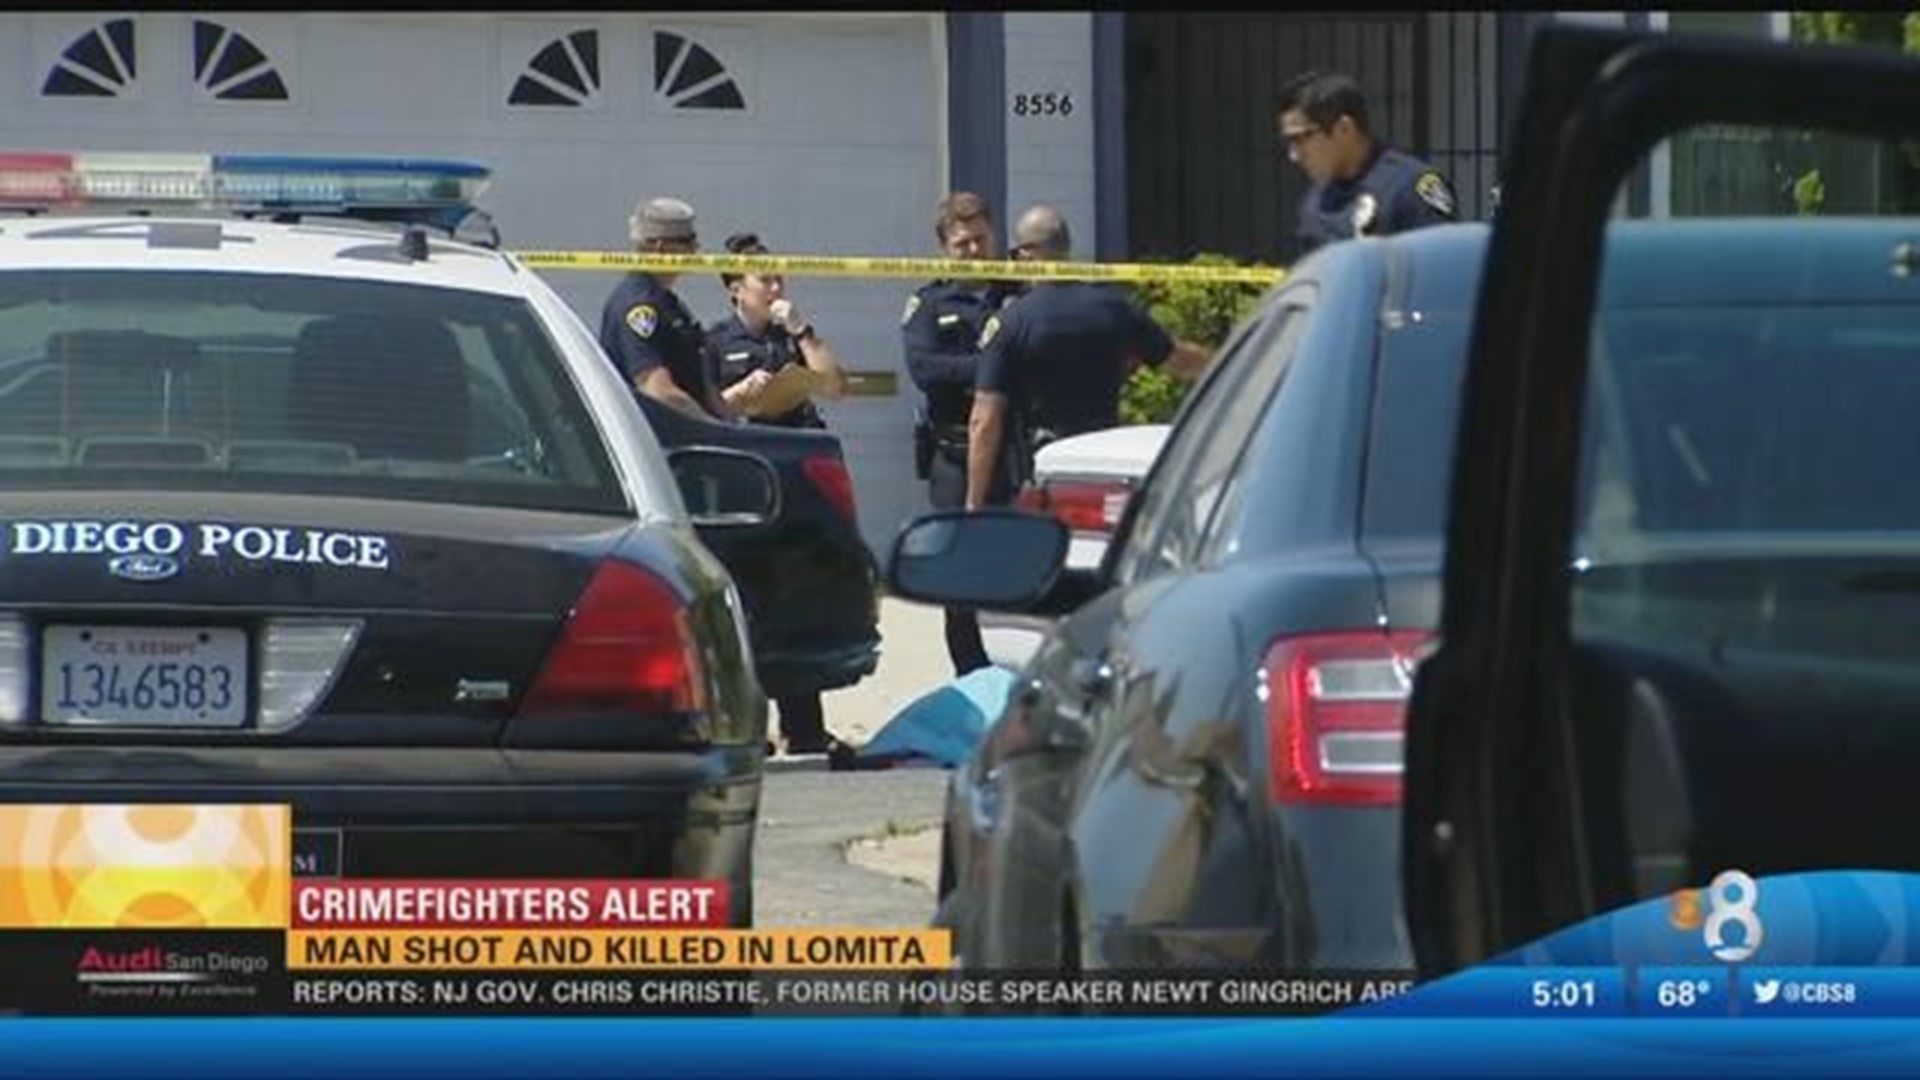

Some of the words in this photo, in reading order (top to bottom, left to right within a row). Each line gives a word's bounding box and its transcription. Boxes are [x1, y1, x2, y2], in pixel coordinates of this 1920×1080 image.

[1013, 94, 1073, 116] 8556
[12, 522, 184, 554] DIEGO
[200, 524, 390, 569] POLICE
[57, 663, 233, 711] 1346583
